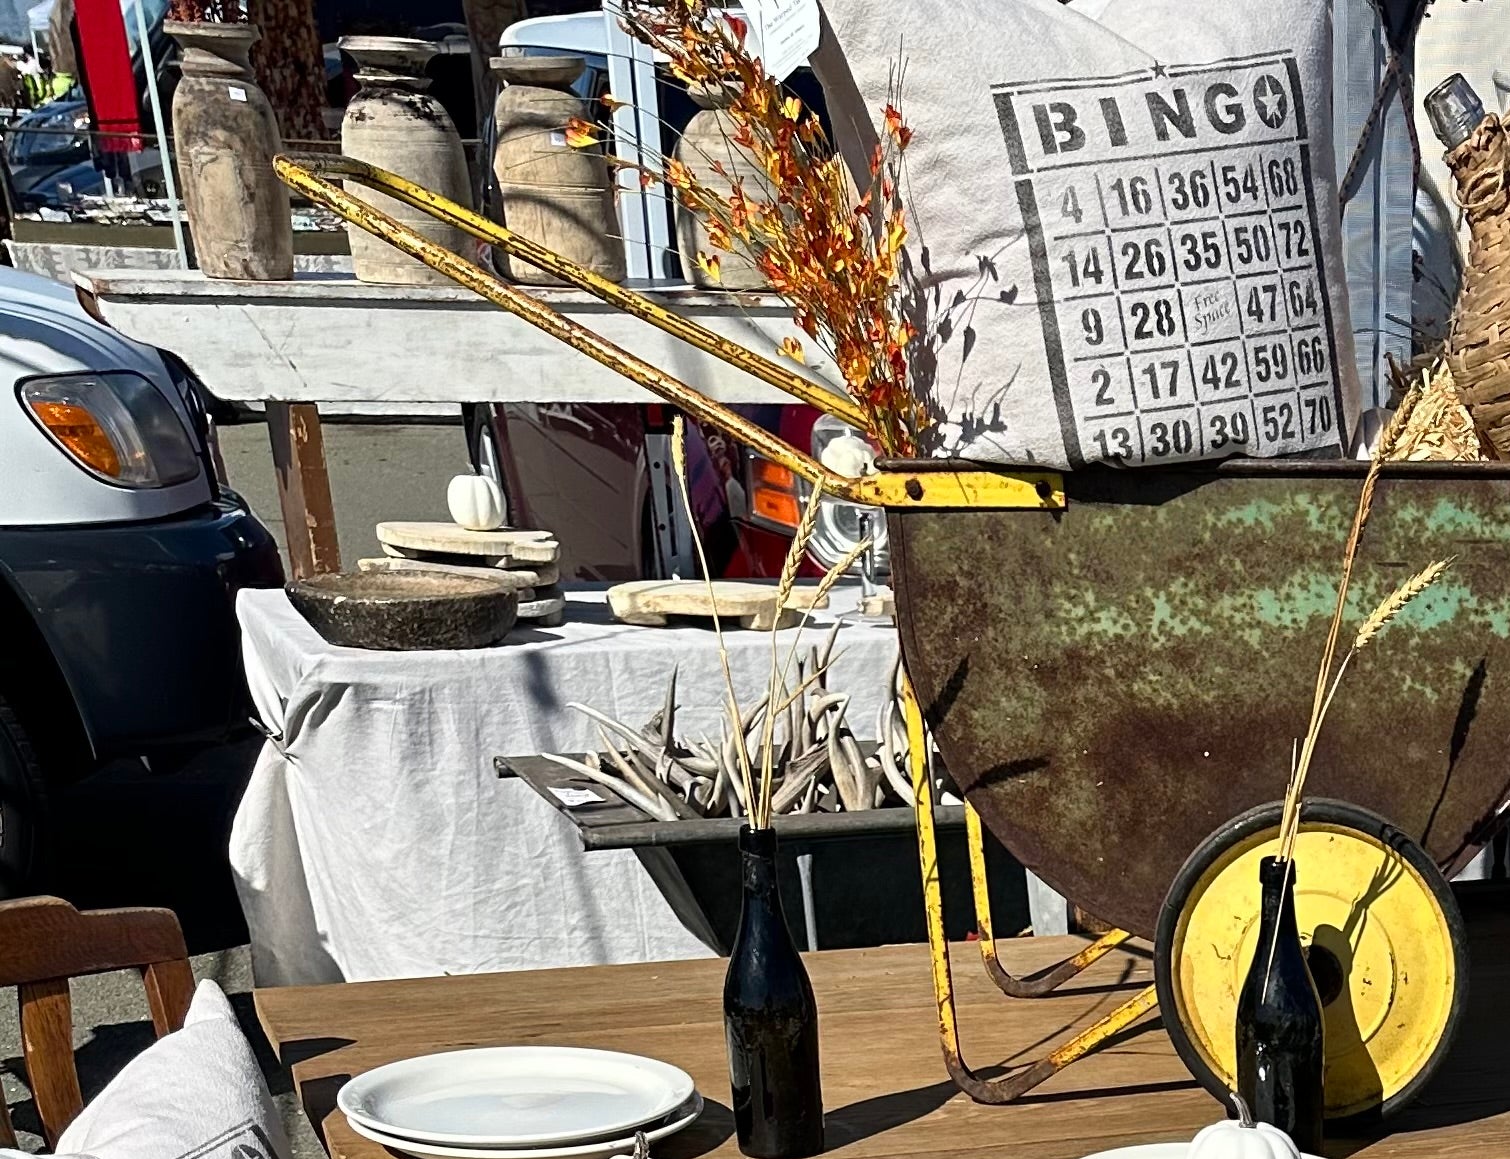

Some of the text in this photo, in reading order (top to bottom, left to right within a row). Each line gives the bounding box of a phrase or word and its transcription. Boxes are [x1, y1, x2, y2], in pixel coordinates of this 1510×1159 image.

[1033, 74, 1287, 155] BINGO
[1061, 157, 1298, 223] 4 16 36 54 68
[1062, 220, 1309, 287] 14 26 35 50 72
[1081, 308, 1104, 345] 9
[1130, 299, 1176, 340] 28
[1248, 285, 1278, 322] 47
[1288, 278, 1318, 318] 64
[1091, 336, 1325, 406] 2 17 42 59 66
[1093, 396, 1331, 460] 13 30 39 52 70
